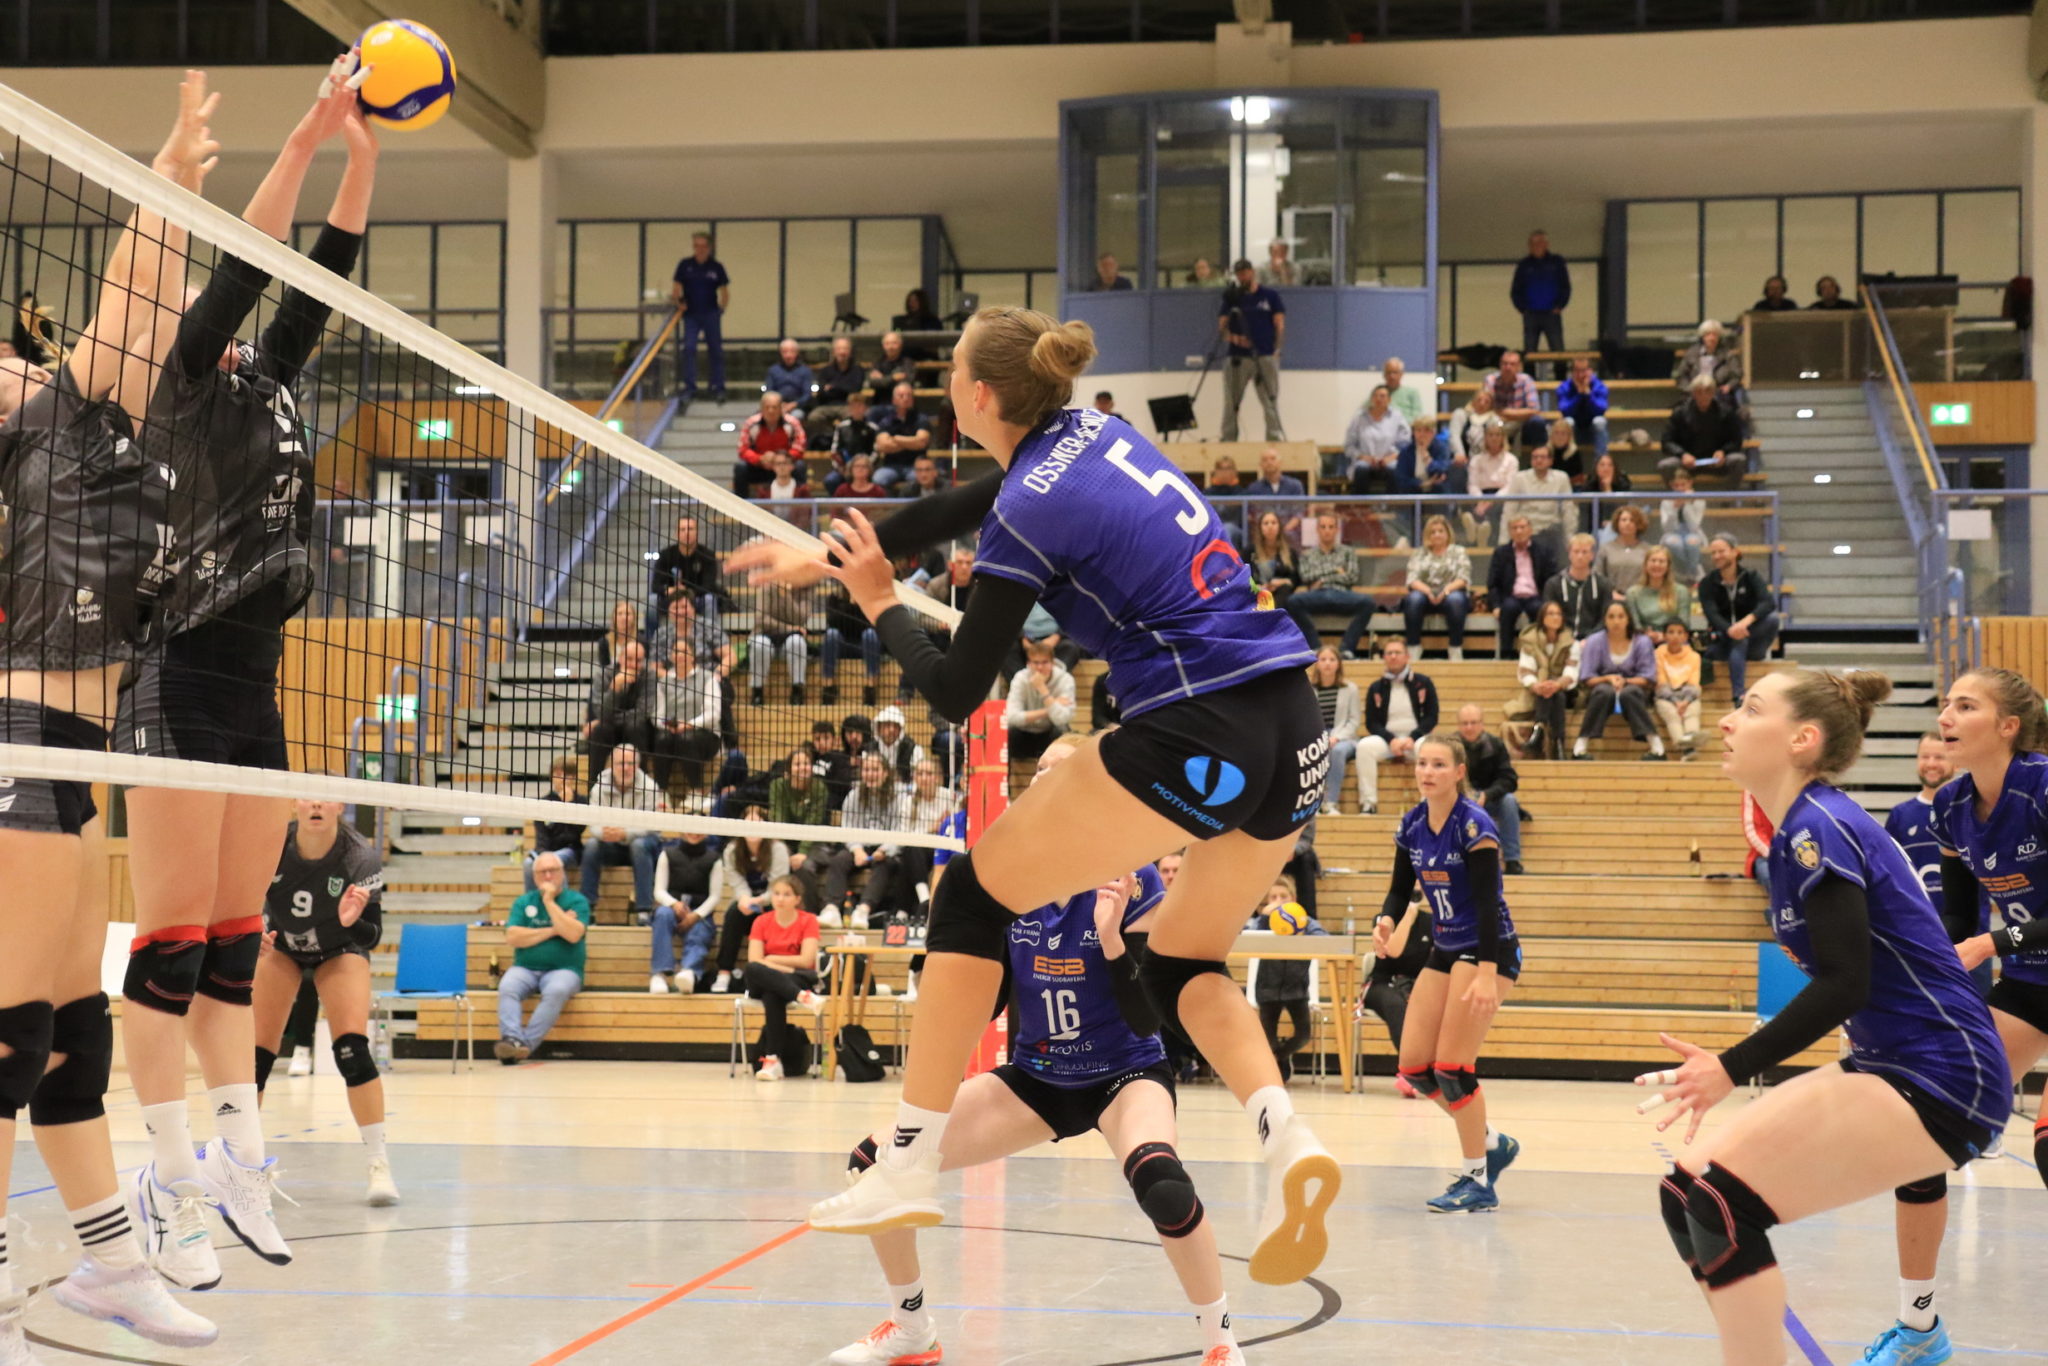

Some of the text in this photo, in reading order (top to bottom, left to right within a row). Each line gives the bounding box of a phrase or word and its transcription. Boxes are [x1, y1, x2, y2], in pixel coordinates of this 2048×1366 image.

[1104, 438, 1210, 536] 5
[1151, 781, 1225, 831] MOTIVMEDIA
[290, 889, 314, 918] 9
[1433, 888, 1455, 921] 15
[1033, 955, 1086, 976] ESB
[1041, 988, 1081, 1040] 16
